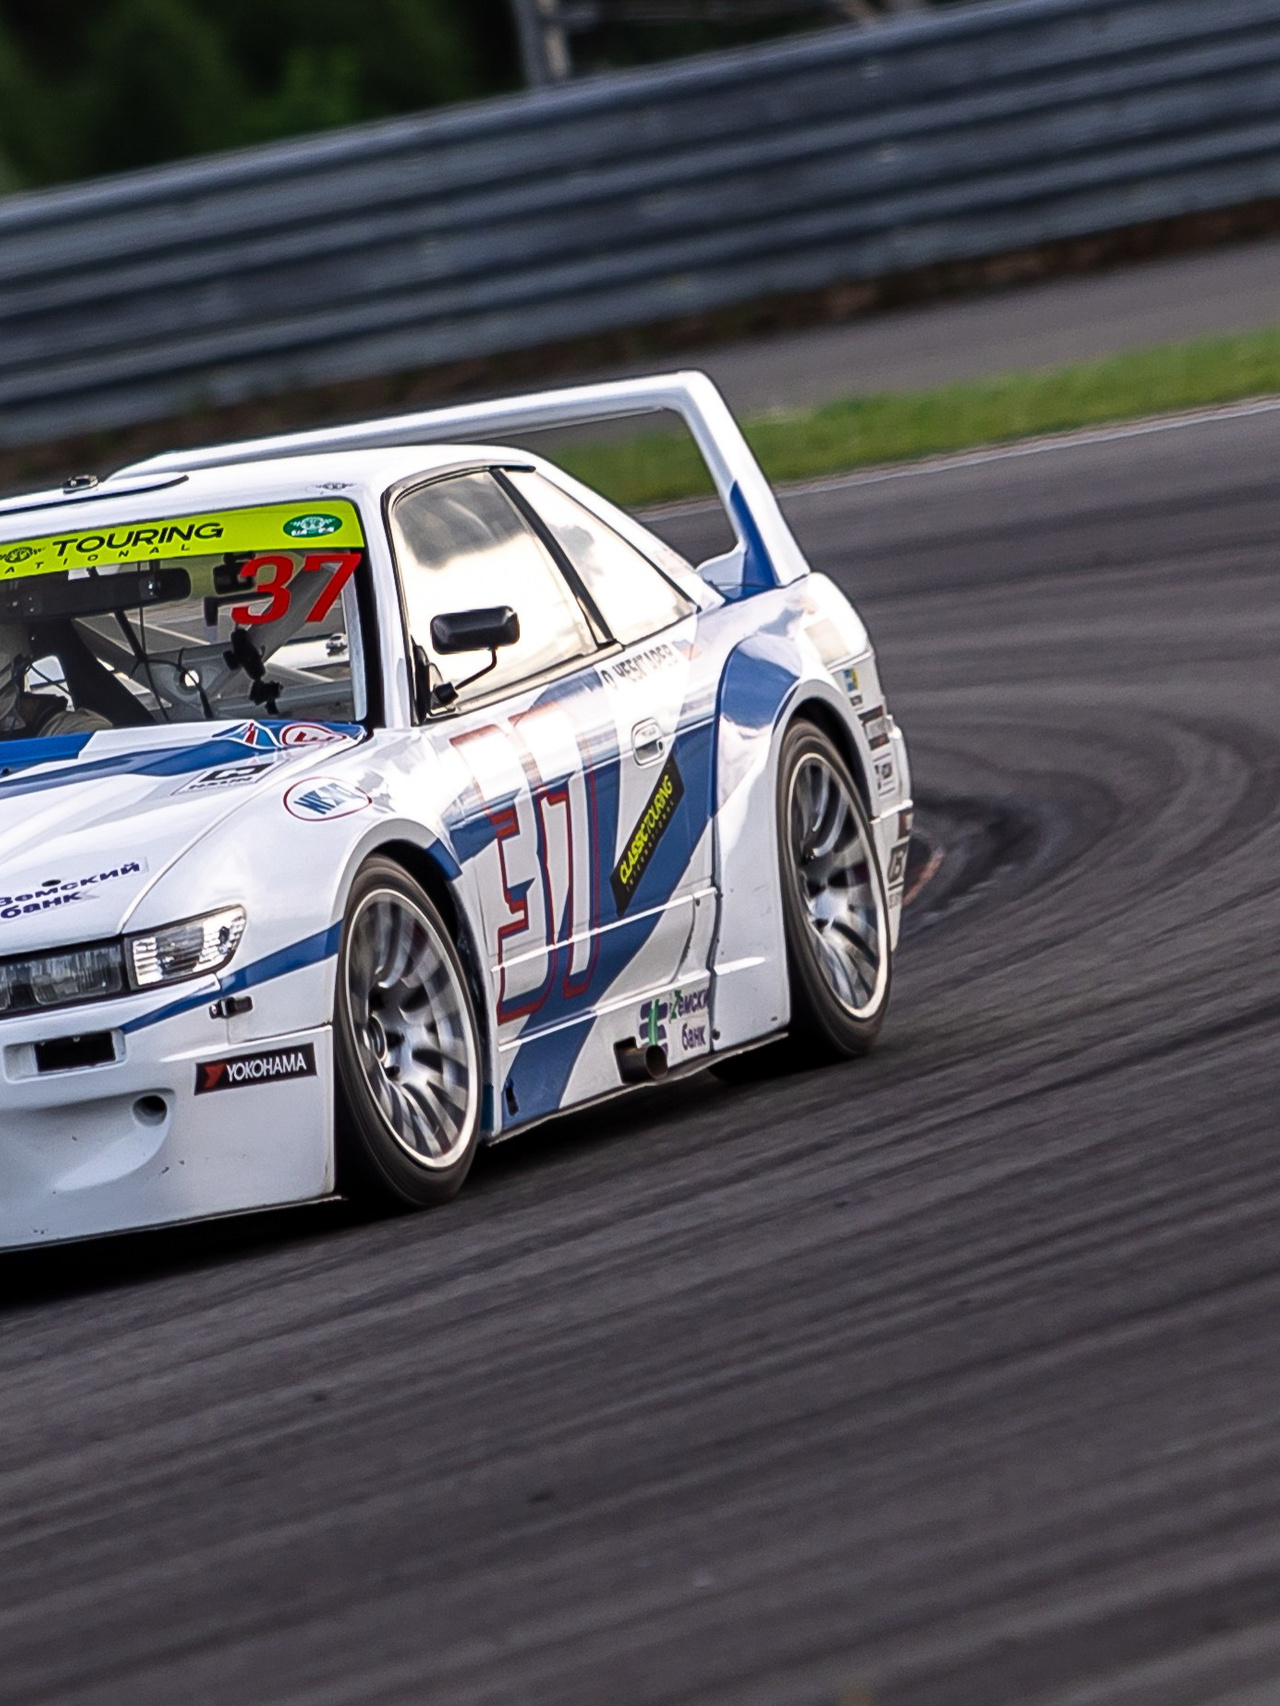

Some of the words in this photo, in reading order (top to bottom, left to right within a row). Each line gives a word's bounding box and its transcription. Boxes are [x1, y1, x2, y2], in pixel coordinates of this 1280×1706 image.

[52, 522, 224, 558] TOURING
[231, 552, 362, 626] 37
[0, 891, 82, 919] банк
[681, 1022, 707, 1051] банк
[226, 1052, 308, 1082] YOKOHAMA
